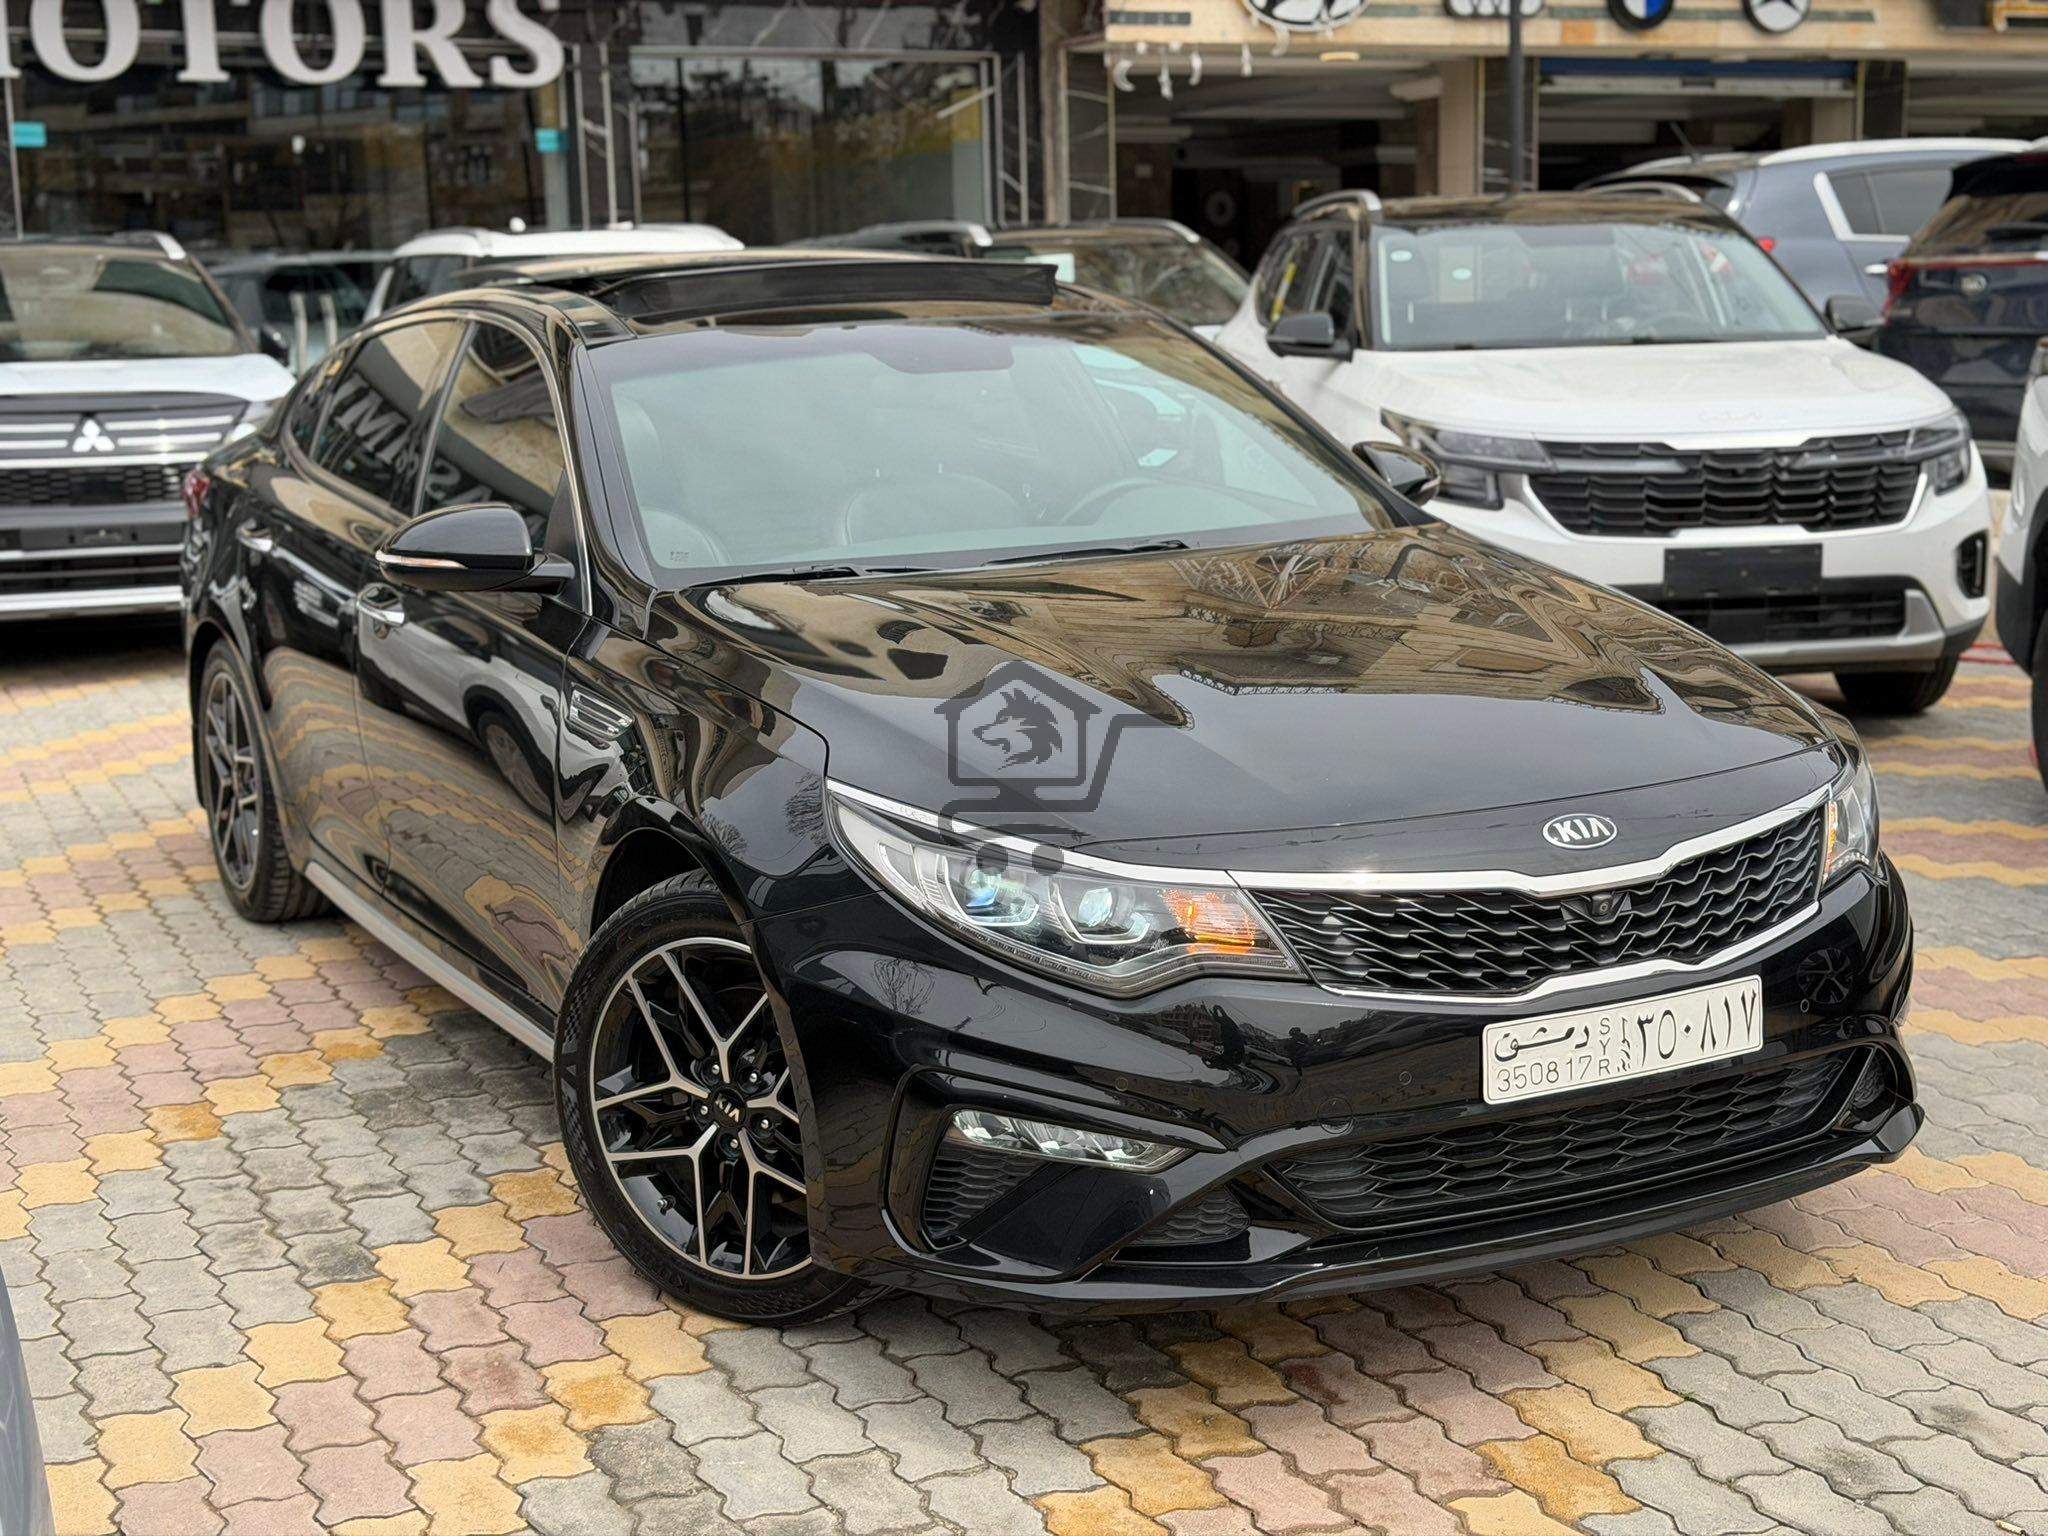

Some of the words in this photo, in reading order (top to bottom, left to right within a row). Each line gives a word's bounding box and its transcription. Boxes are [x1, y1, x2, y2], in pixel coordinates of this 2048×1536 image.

[0, 0, 566, 88] OTORS
[1553, 817, 1611, 843] KIA
[1494, 1025, 1590, 1062] دمشق
[1496, 1055, 1592, 1093] 350817
[715, 1093, 740, 1123] KIA
